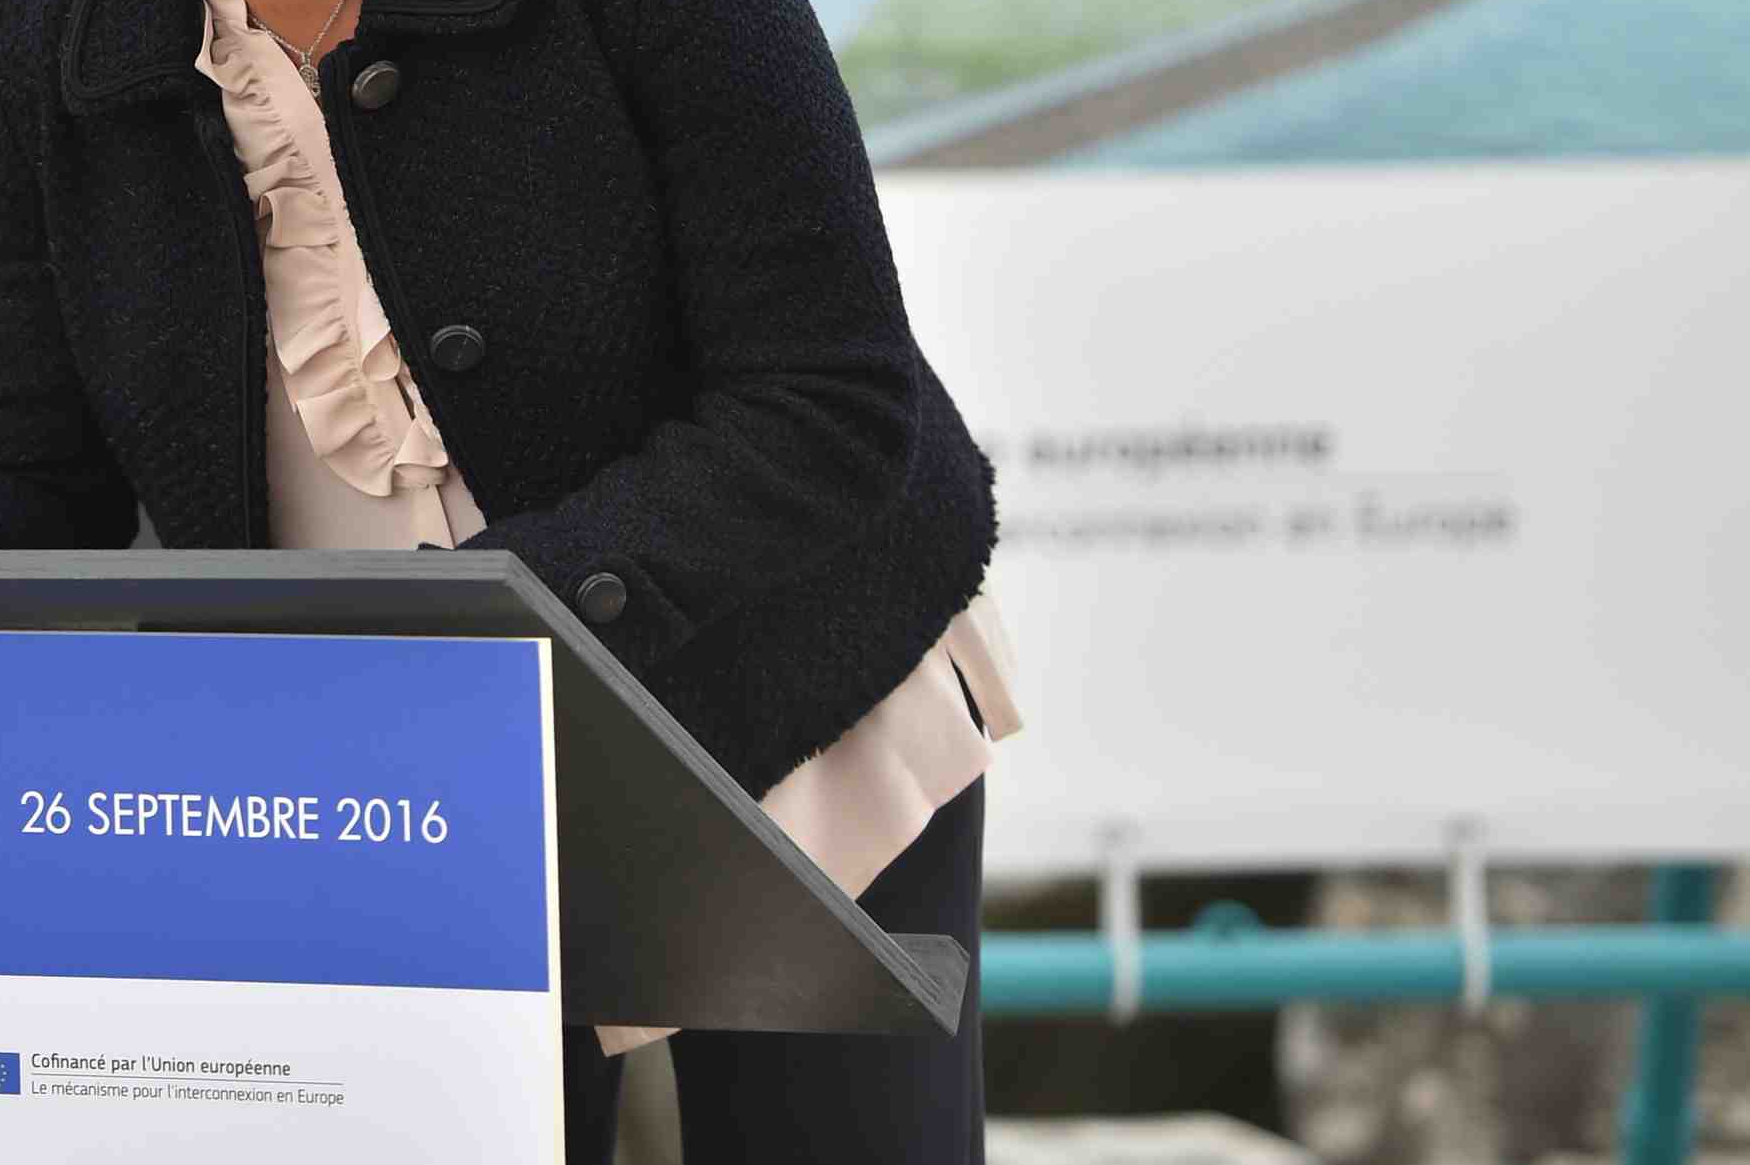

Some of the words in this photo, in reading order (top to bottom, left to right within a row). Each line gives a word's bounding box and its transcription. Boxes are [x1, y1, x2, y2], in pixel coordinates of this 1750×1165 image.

[19, 791, 72, 835] 26
[87, 792, 320, 840] SEPTEMBRE
[336, 798, 449, 844] 2016
[31, 1053, 106, 1070] Cofinancé
[111, 1059, 137, 1074] par
[142, 1055, 195, 1073] l'Union
[200, 1058, 291, 1077] européenne
[31, 1080, 47, 1095] Le
[51, 1081, 129, 1097] mécanisme
[132, 1085, 163, 1100] pour
[167, 1084, 273, 1102] l'interconnexion
[277, 1091, 293, 1103] en
[297, 1088, 345, 1107] Europe
